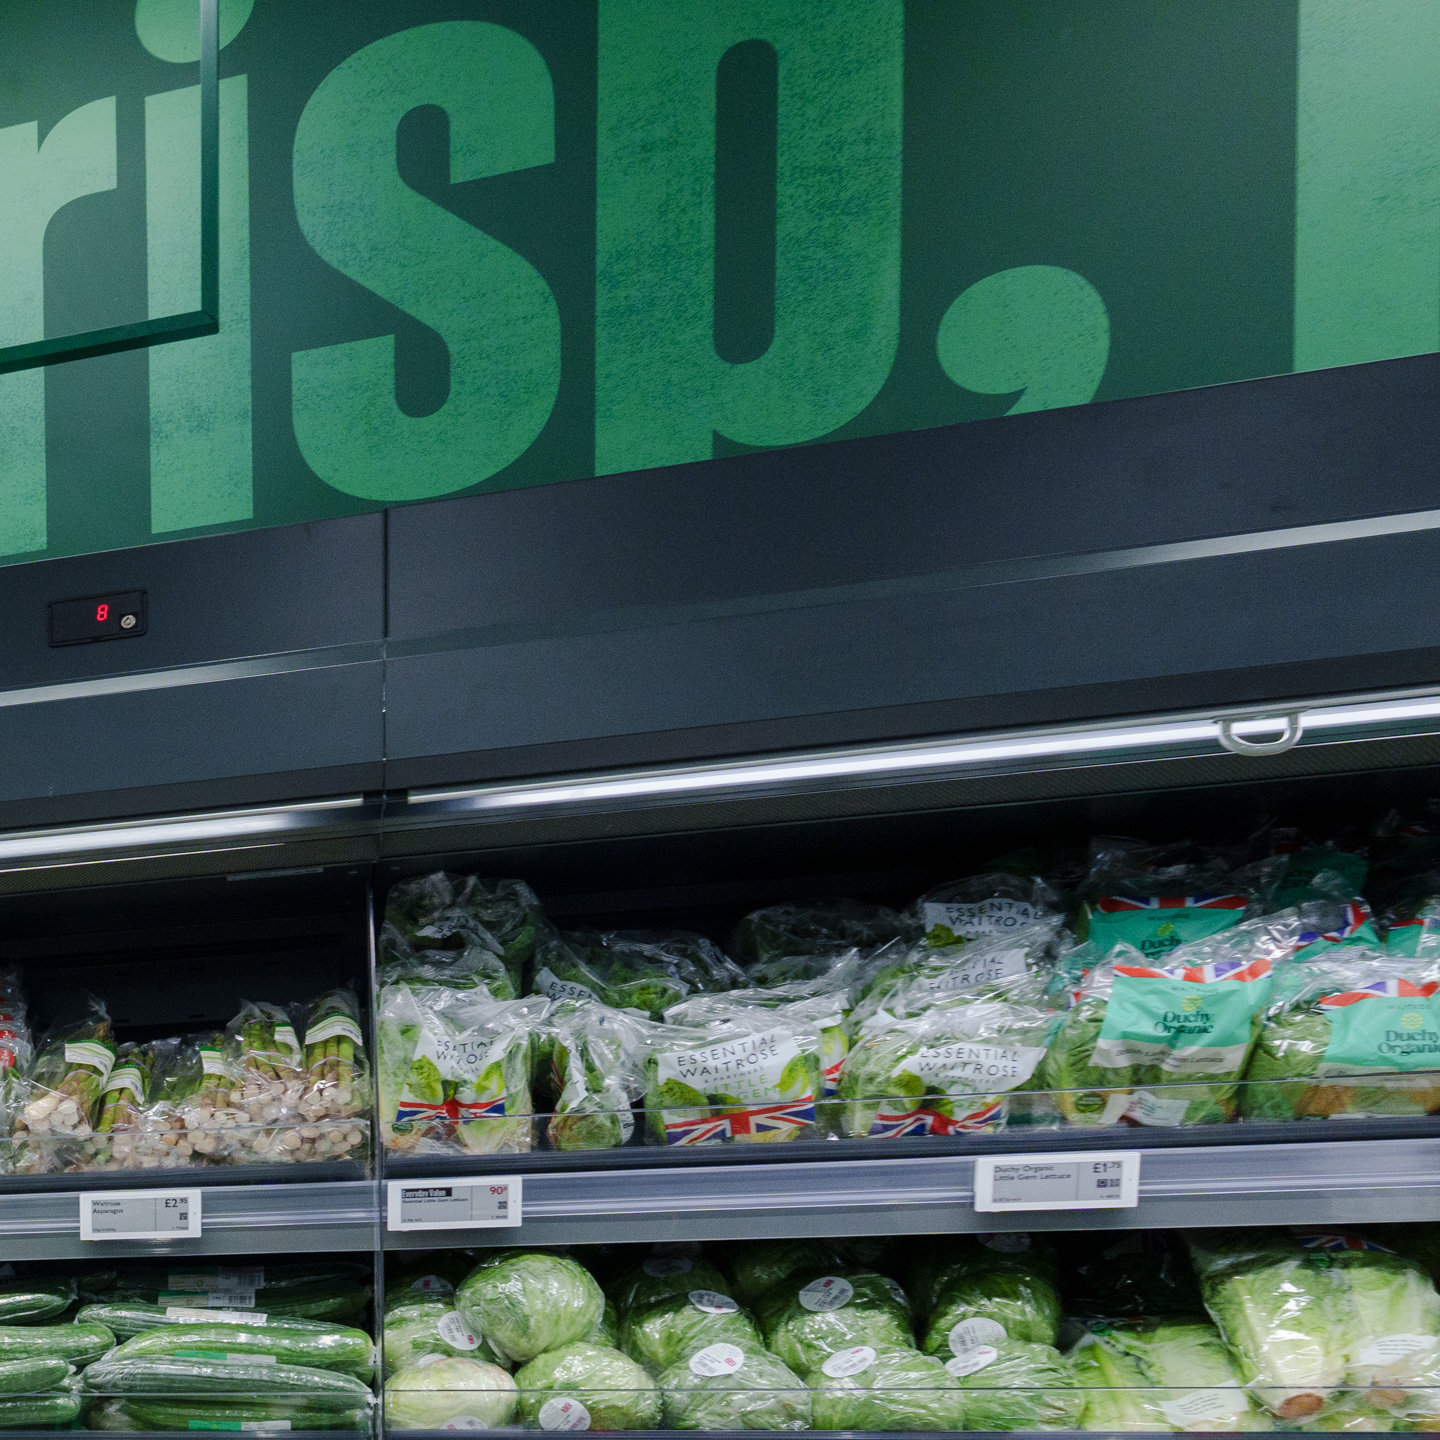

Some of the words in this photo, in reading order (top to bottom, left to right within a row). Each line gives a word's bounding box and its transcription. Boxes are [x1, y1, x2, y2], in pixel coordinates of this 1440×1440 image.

[96, 603, 109, 621] 8
[1163, 1010, 1210, 1026] Duchy
[1154, 1022, 1214, 1036] Organic
[1385, 1029, 1439, 1045] Duchy
[677, 1034, 775, 1067] ESSENTIAL
[921, 1047, 1017, 1061] ESSENTIAL
[680, 1045, 779, 1078] WAITROSE
[918, 1061, 1017, 1077] WAITROSE
[703, 1074, 767, 1094] LITTLE
[736, 1085, 777, 1100] GEM
[994, 1166, 1014, 1175] Duchy
[1016, 1165, 1054, 1173] Organic
[994, 1173, 1015, 1181] Little
[1040, 1172, 1071, 1180] Lettuce
[428, 1189, 446, 1198] Value
[164, 1198, 188, 1208] £2.95
[93, 1208, 124, 1216] Asparagus
